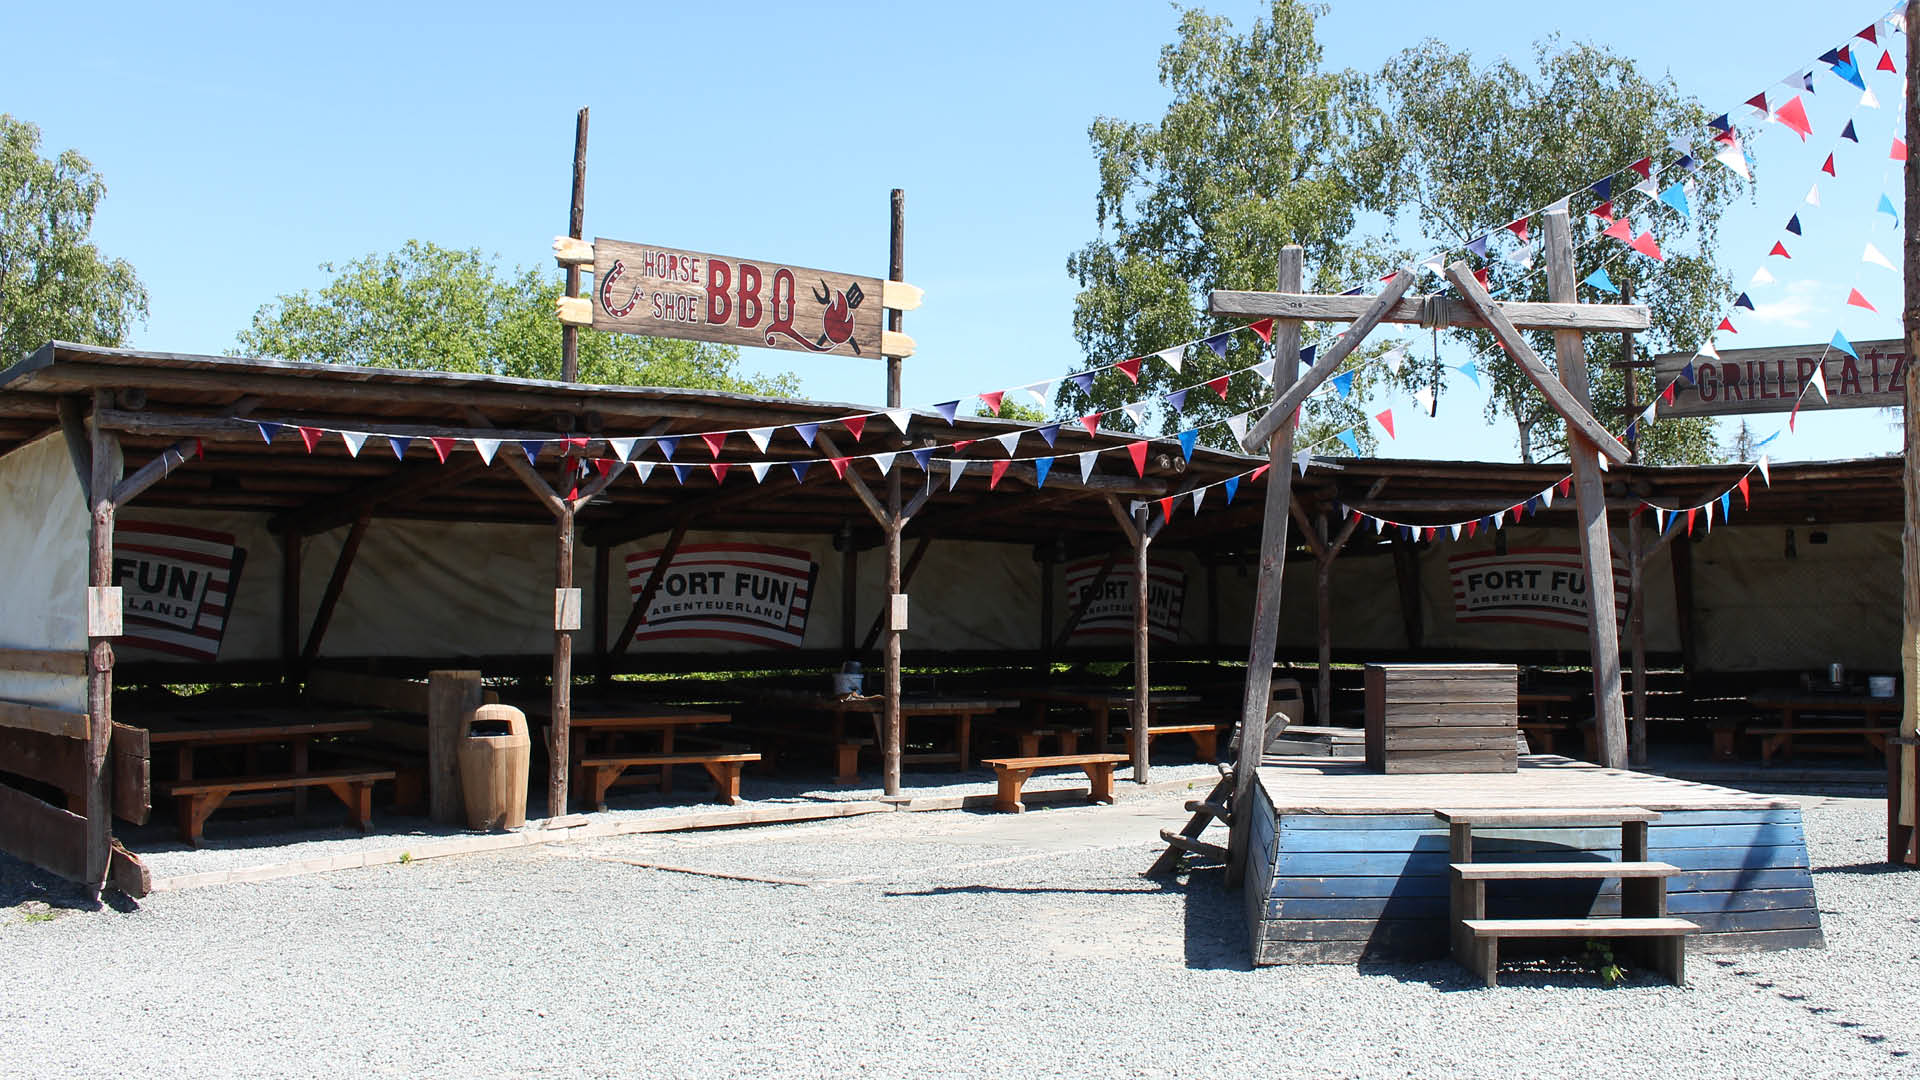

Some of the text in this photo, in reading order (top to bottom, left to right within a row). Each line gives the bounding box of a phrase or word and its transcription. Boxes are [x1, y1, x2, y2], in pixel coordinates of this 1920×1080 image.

[643, 251, 700, 283] HORSE
[652, 291, 698, 323] SHOE
[704, 257, 836, 353] BBQ
[114, 558, 198, 601] FUN
[735, 572, 789, 606] FUN
[1468, 570, 1586, 594] FORT FU
[652, 601, 783, 620] ABENTEUERLAND
[1472, 593, 1587, 609] ABENTEUERLA
